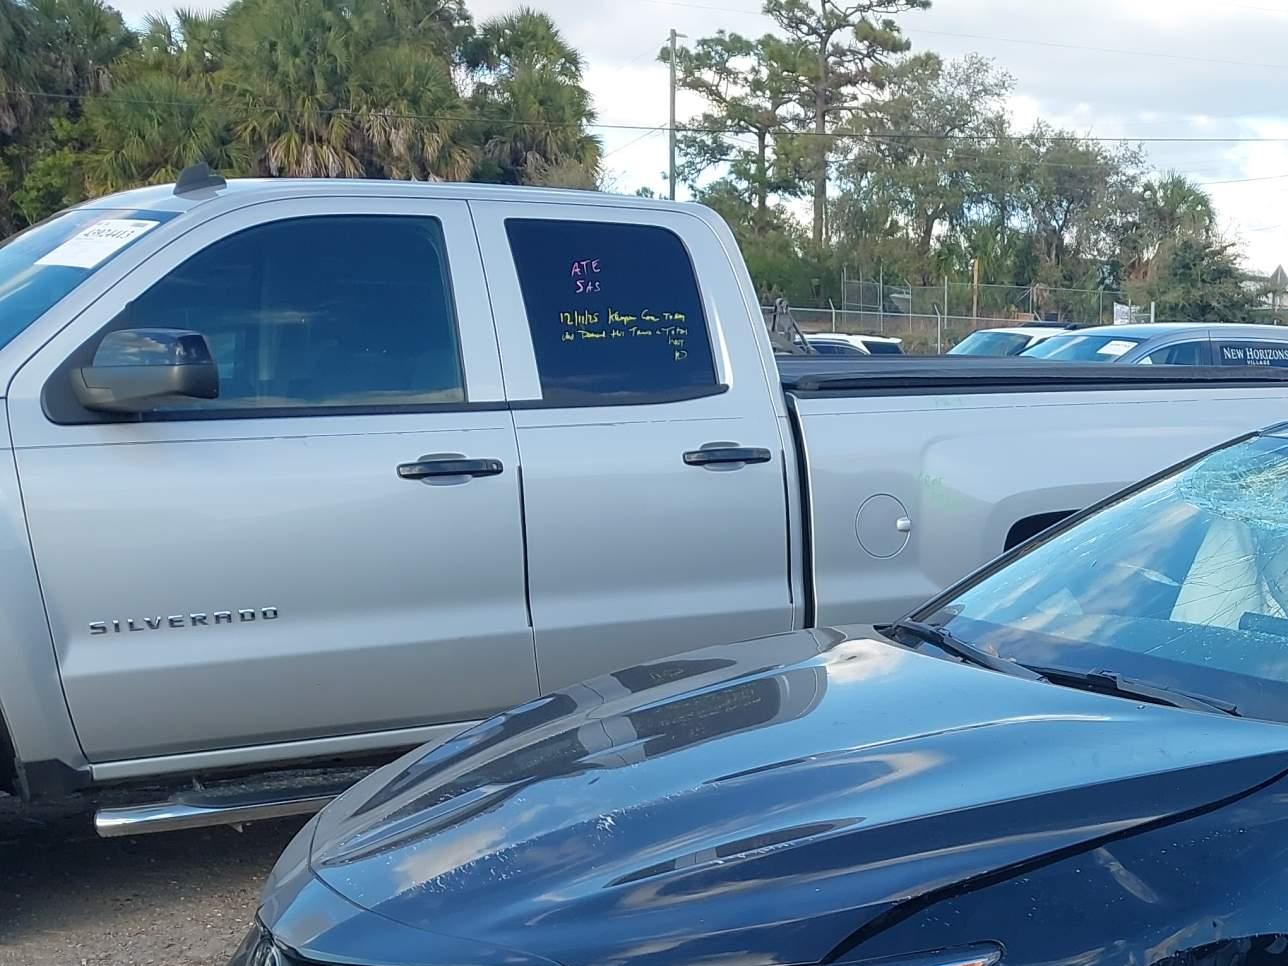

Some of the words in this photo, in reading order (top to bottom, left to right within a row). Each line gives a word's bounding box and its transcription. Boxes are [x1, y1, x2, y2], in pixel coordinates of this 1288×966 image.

[571, 259, 601, 276] ATE
[1223, 347, 1244, 360] NEW
[89, 606, 280, 635] SILVERADO
